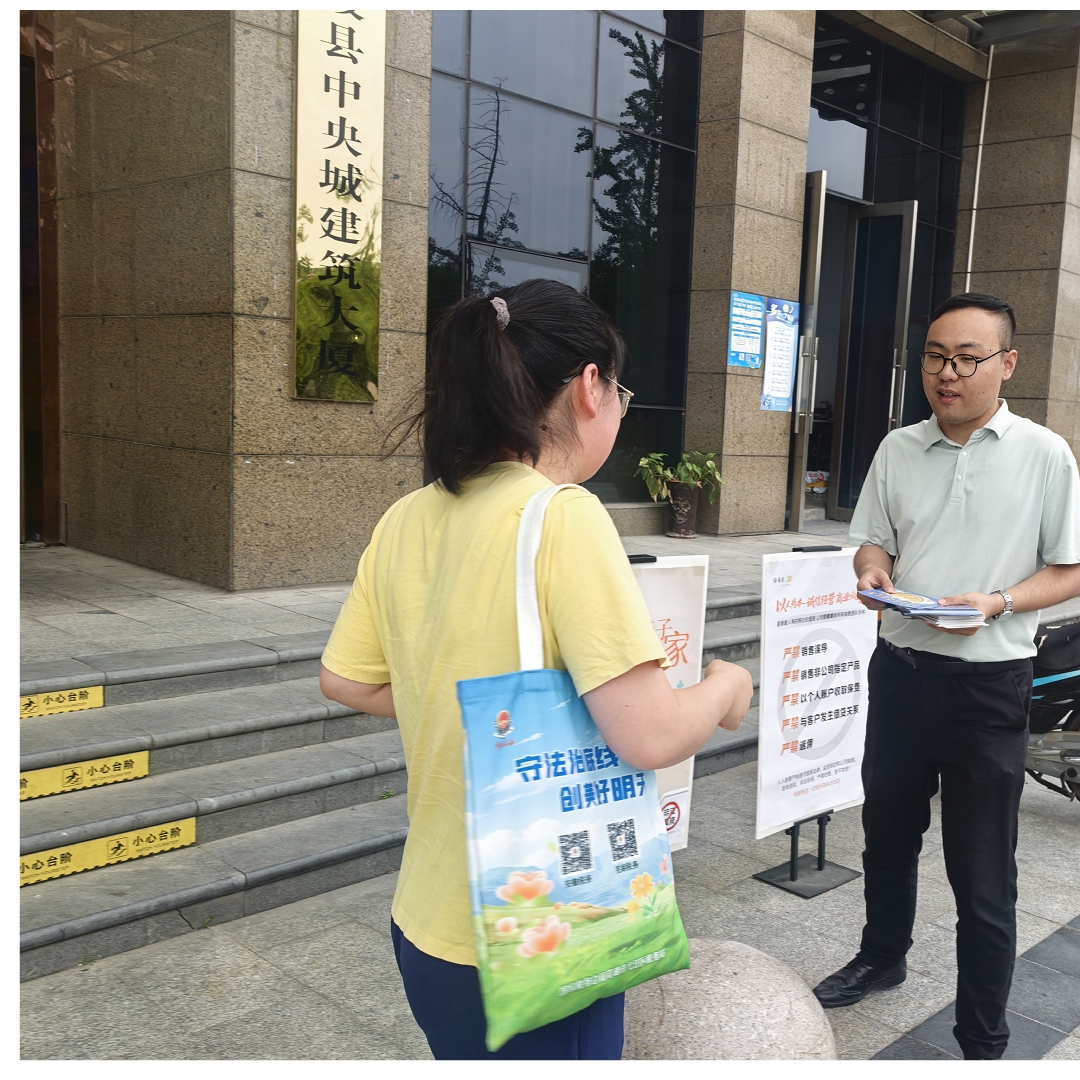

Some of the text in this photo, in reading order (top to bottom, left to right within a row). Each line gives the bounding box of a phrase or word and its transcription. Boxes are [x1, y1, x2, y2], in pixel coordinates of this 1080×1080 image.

[319, 10, 365, 377] 县中央城建筑大厦
[664, 630, 689, 668] 家
[42, 690, 89, 705] 小心台阶
[800, 682, 860, 704] 以个人账户收取保费
[800, 704, 860, 728] 与客户发生借贷关系
[86, 759, 135, 776] 小心台阶
[132, 826, 182, 847] 小心台阶
[20, 851, 73, 874] 小心台阶
